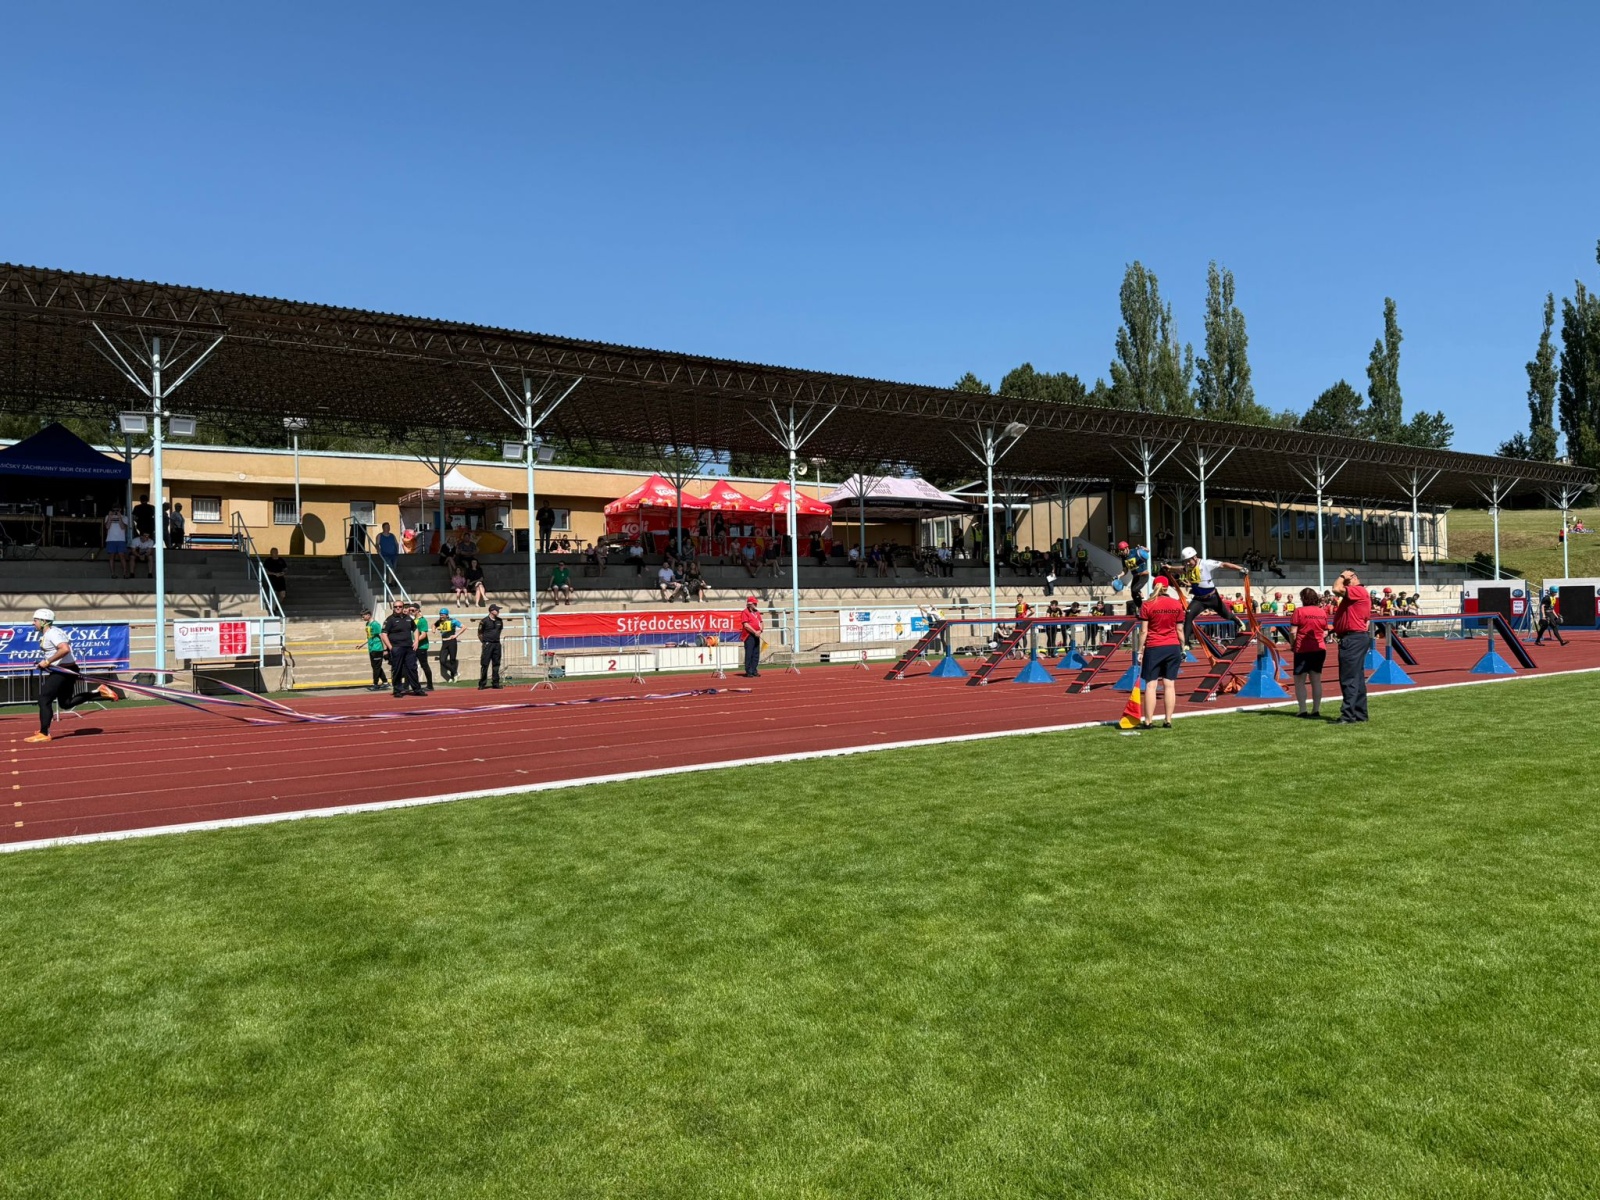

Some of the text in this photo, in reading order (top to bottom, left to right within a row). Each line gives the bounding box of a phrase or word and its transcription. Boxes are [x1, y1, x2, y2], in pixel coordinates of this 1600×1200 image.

[617, 614, 734, 632] Středočeský kraj
[698, 653, 704, 664] 1
[861, 650, 868, 661] 3
[608, 659, 617, 671] 2
